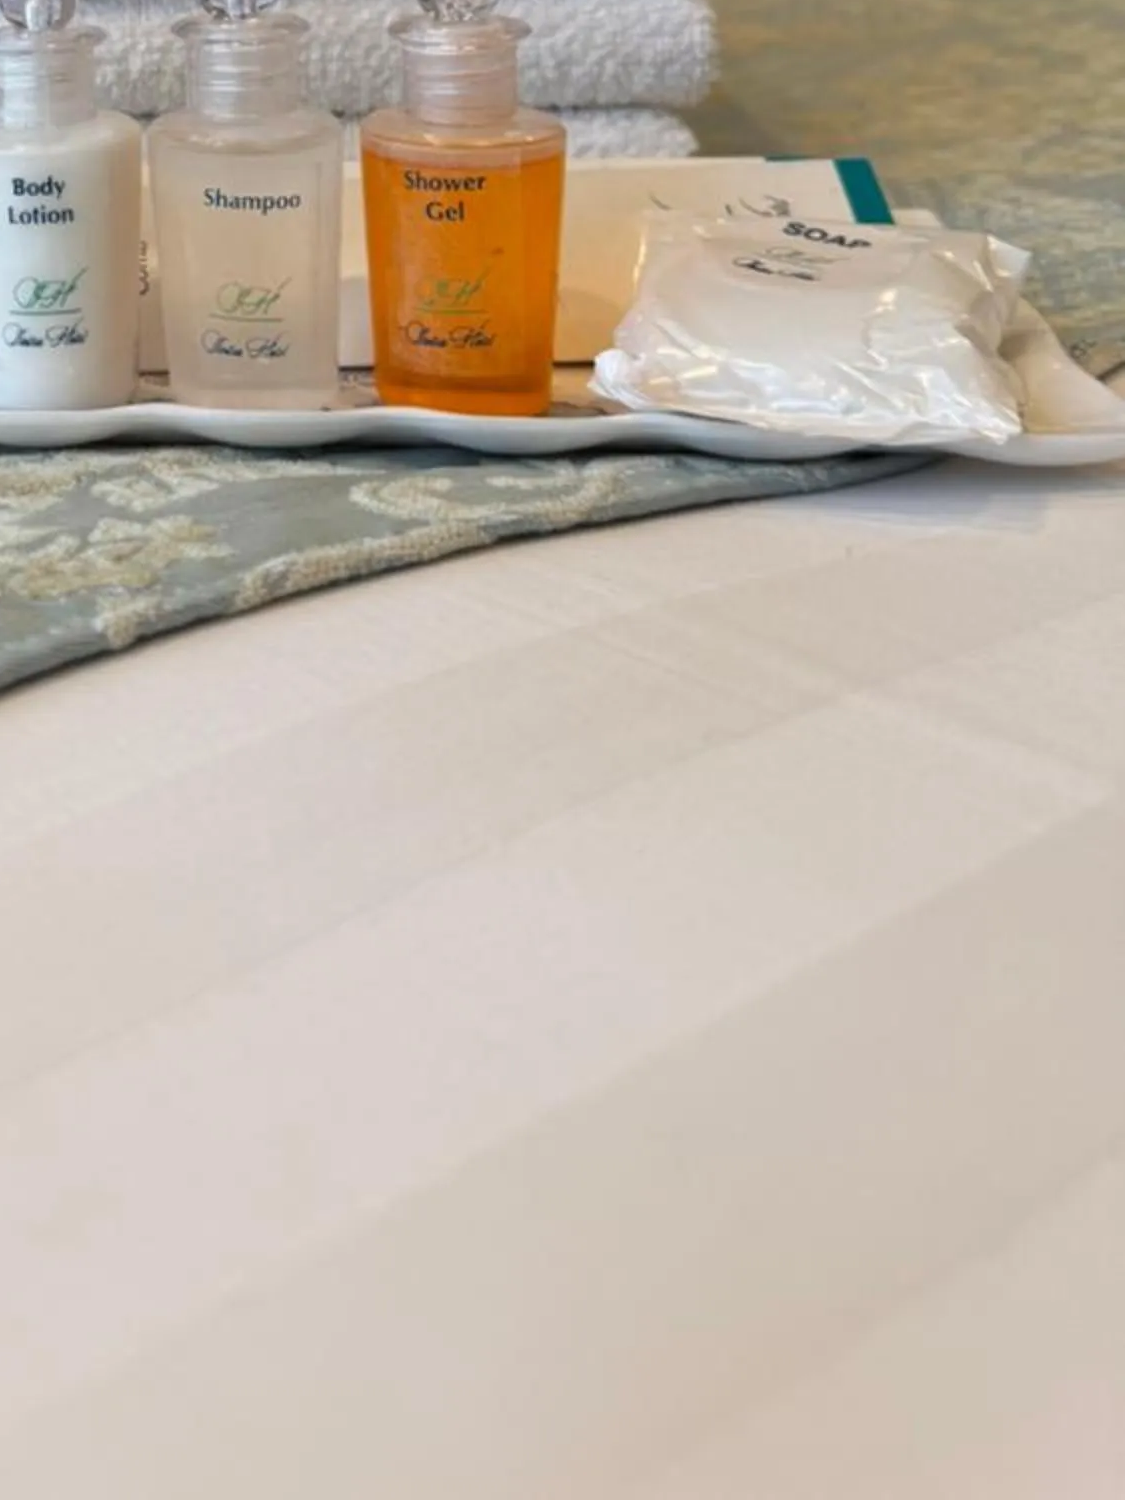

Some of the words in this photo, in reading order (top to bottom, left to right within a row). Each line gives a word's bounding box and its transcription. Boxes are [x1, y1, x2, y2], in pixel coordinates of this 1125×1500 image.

[11, 175, 66, 199] Body
[403, 169, 487, 192] Shower
[203, 187, 302, 216] Shampoo
[425, 201, 465, 222] Gel
[7, 204, 75, 225] Lotion
[782, 221, 873, 250] SOAP
